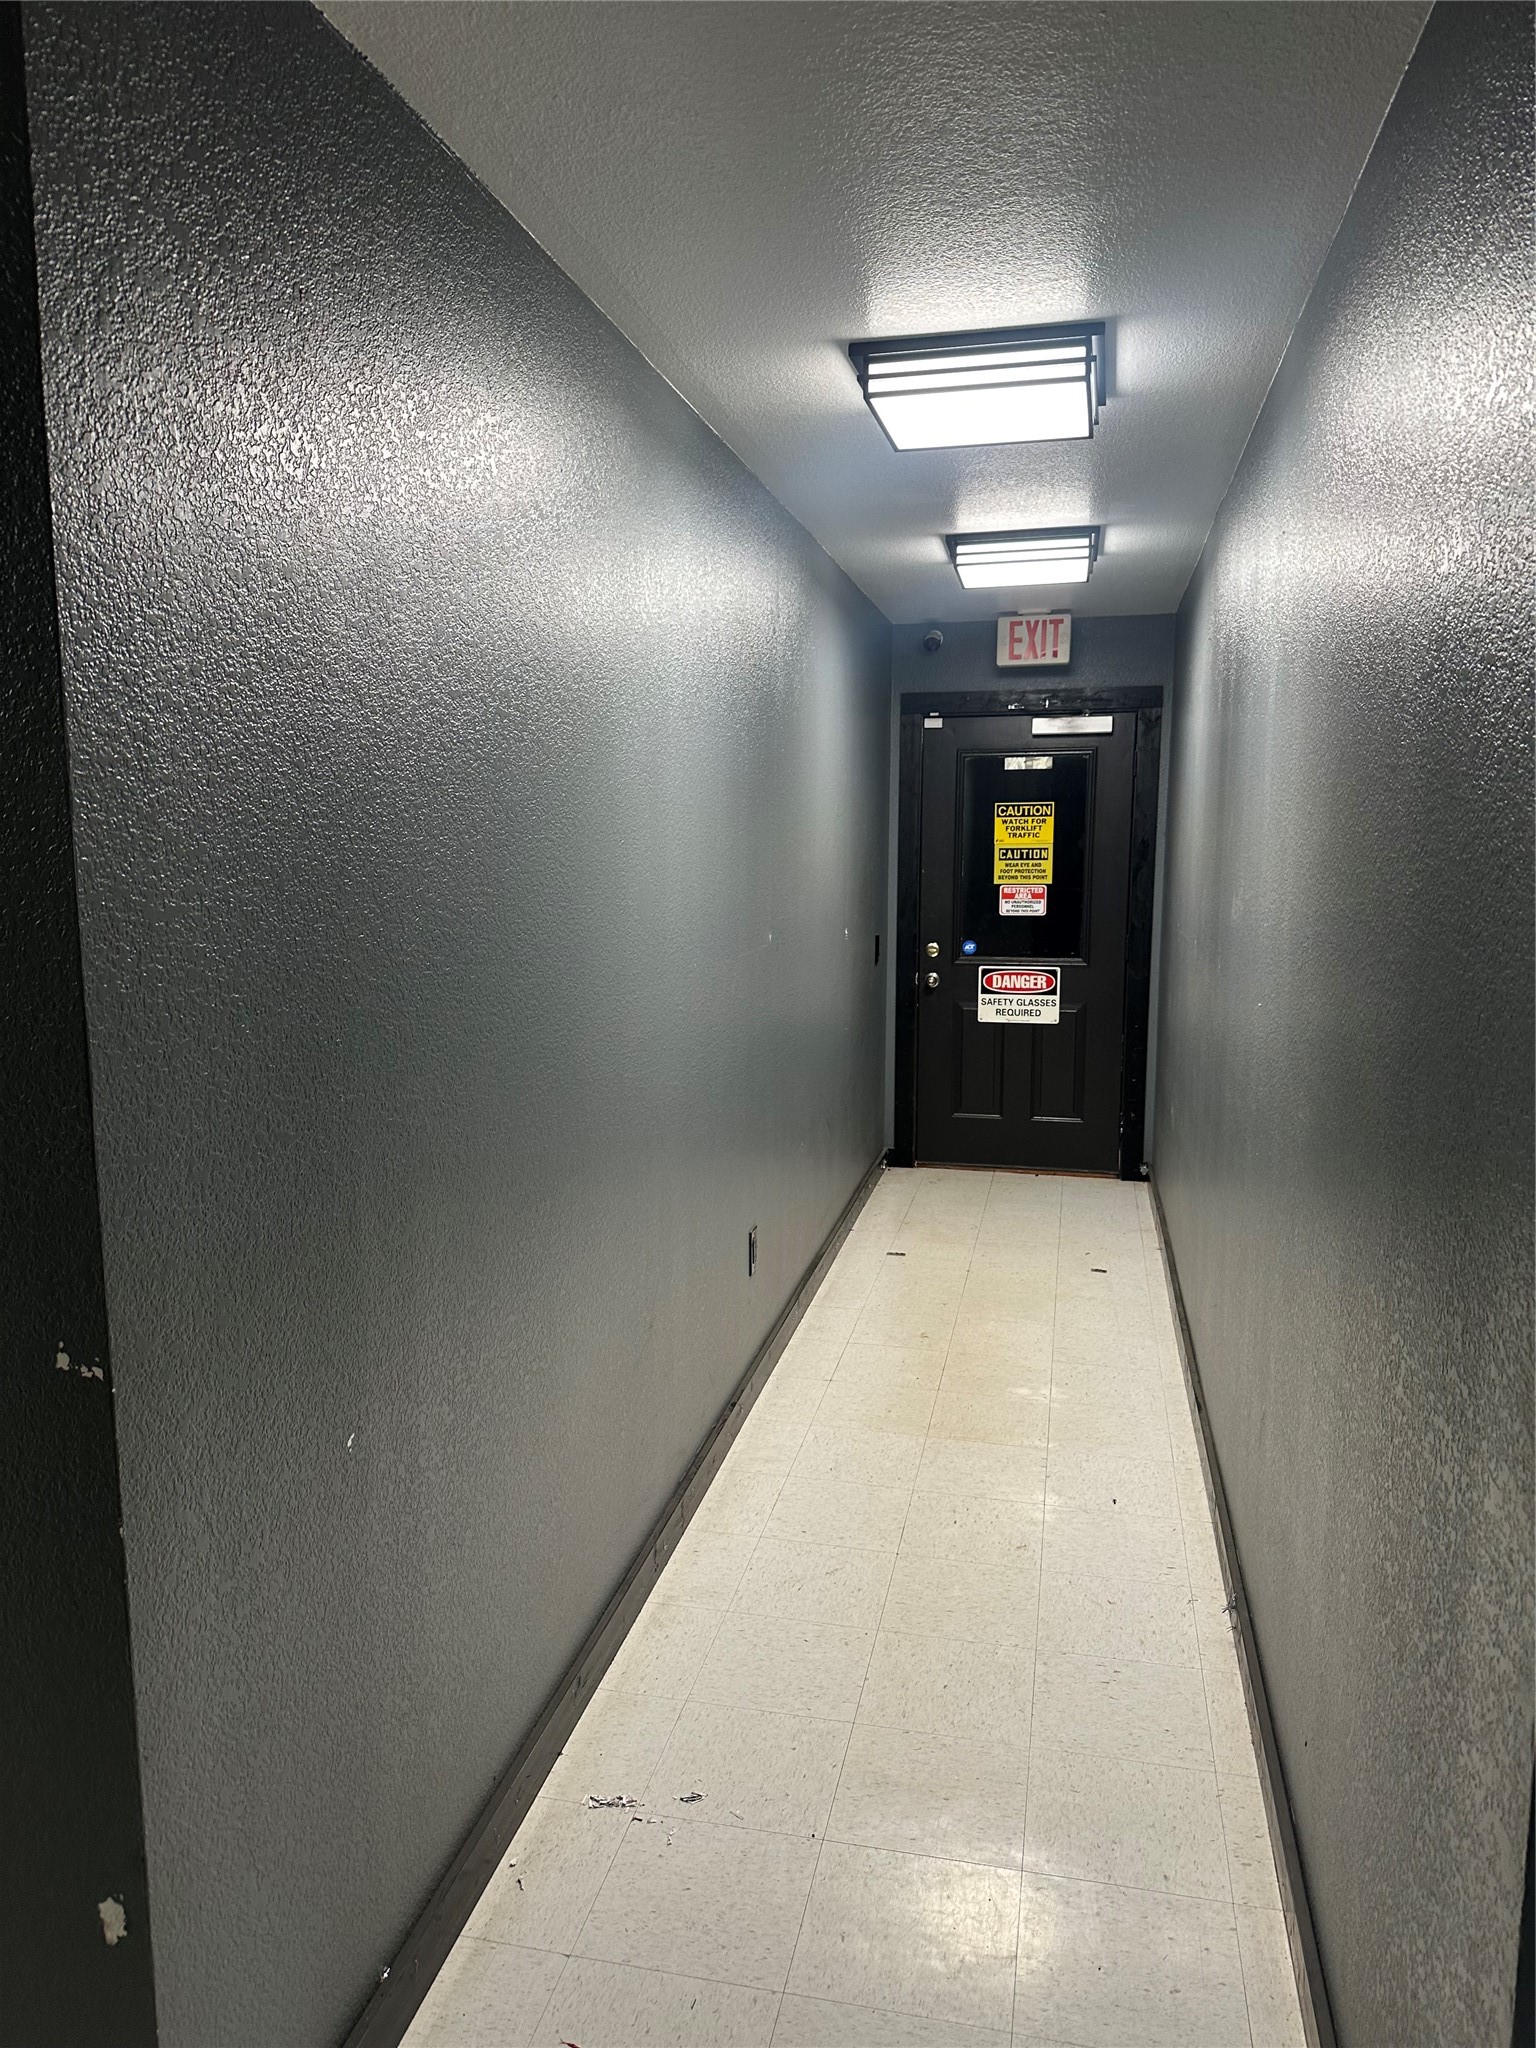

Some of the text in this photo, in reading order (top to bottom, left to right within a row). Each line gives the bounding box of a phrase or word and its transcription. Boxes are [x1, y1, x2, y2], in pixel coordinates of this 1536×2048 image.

[1008, 618, 1064, 661] EXIT
[998, 805, 1051, 816] CAUTION
[999, 849, 1048, 859] CAUTION
[992, 974, 1047, 989] DANGER
[981, 997, 1057, 1007] SAFETY GLASSES
[995, 1008, 1042, 1017] REQUIRED
